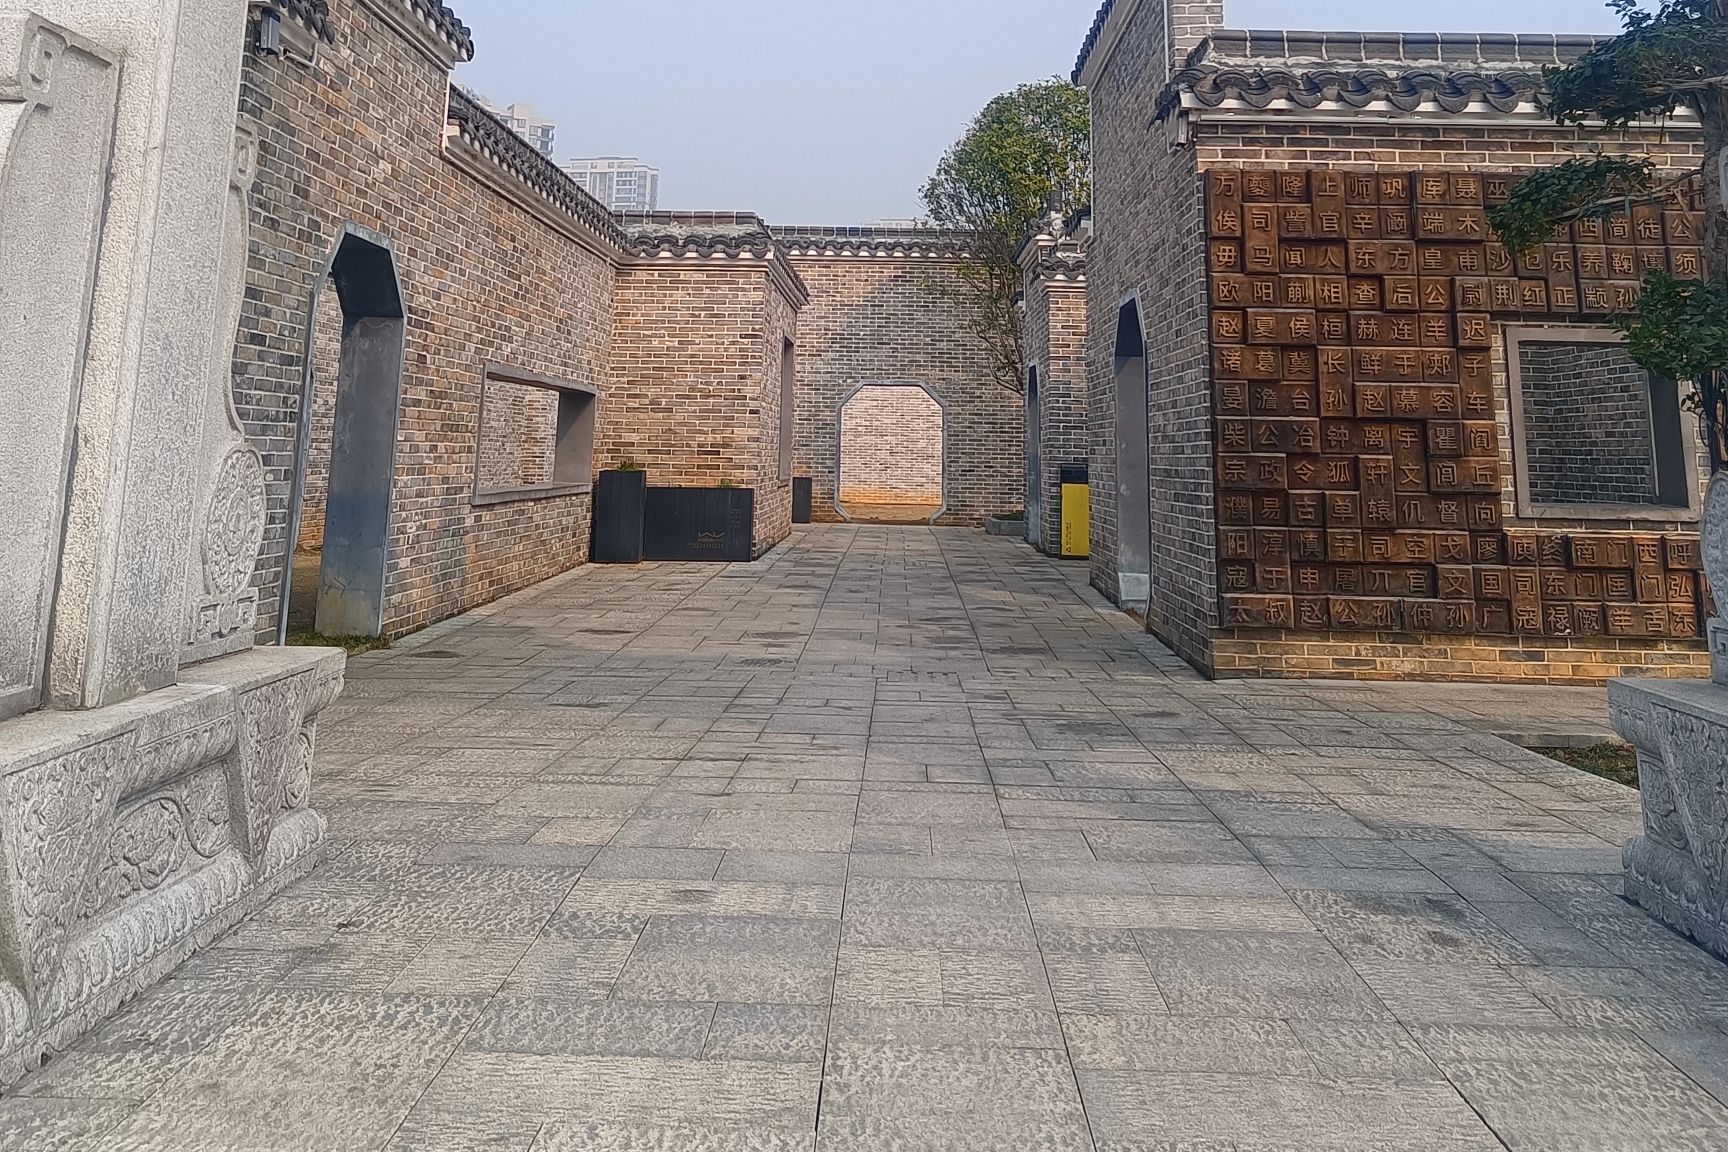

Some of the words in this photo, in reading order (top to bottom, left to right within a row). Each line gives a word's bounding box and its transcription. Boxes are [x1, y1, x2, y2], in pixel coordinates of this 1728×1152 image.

[1282, 177, 1302, 197] 隆
[1351, 177, 1371, 198] 师
[1383, 178, 1405, 198] 巩
[1456, 178, 1477, 198] 聂
[1353, 212, 1374, 233] 辛
[1581, 251, 1605, 273] 养
[1675, 253, 1698, 275] 须
[1321, 282, 1342, 304] 相
[1354, 283, 1377, 305] 查
[1392, 283, 1413, 305] 后
[1522, 285, 1545, 306] 红
[1218, 316, 1239, 338] 赵
[1363, 389, 1385, 412] 赵
[1224, 423, 1245, 446] 柴
[1435, 427, 1457, 450] 瞿
[1261, 497, 1281, 520] 易
[1475, 502, 1496, 524] 向
[1298, 533, 1321, 556] 慎
[1477, 537, 1498, 560] 廖
[1444, 570, 1467, 593] 文
[1481, 571, 1502, 595] 国
[1669, 575, 1692, 598] 弘
[1300, 600, 1324, 625] 赵
[1482, 605, 1504, 628] 广
[1547, 607, 1571, 631] 禄
[1673, 608, 1697, 632] 东
